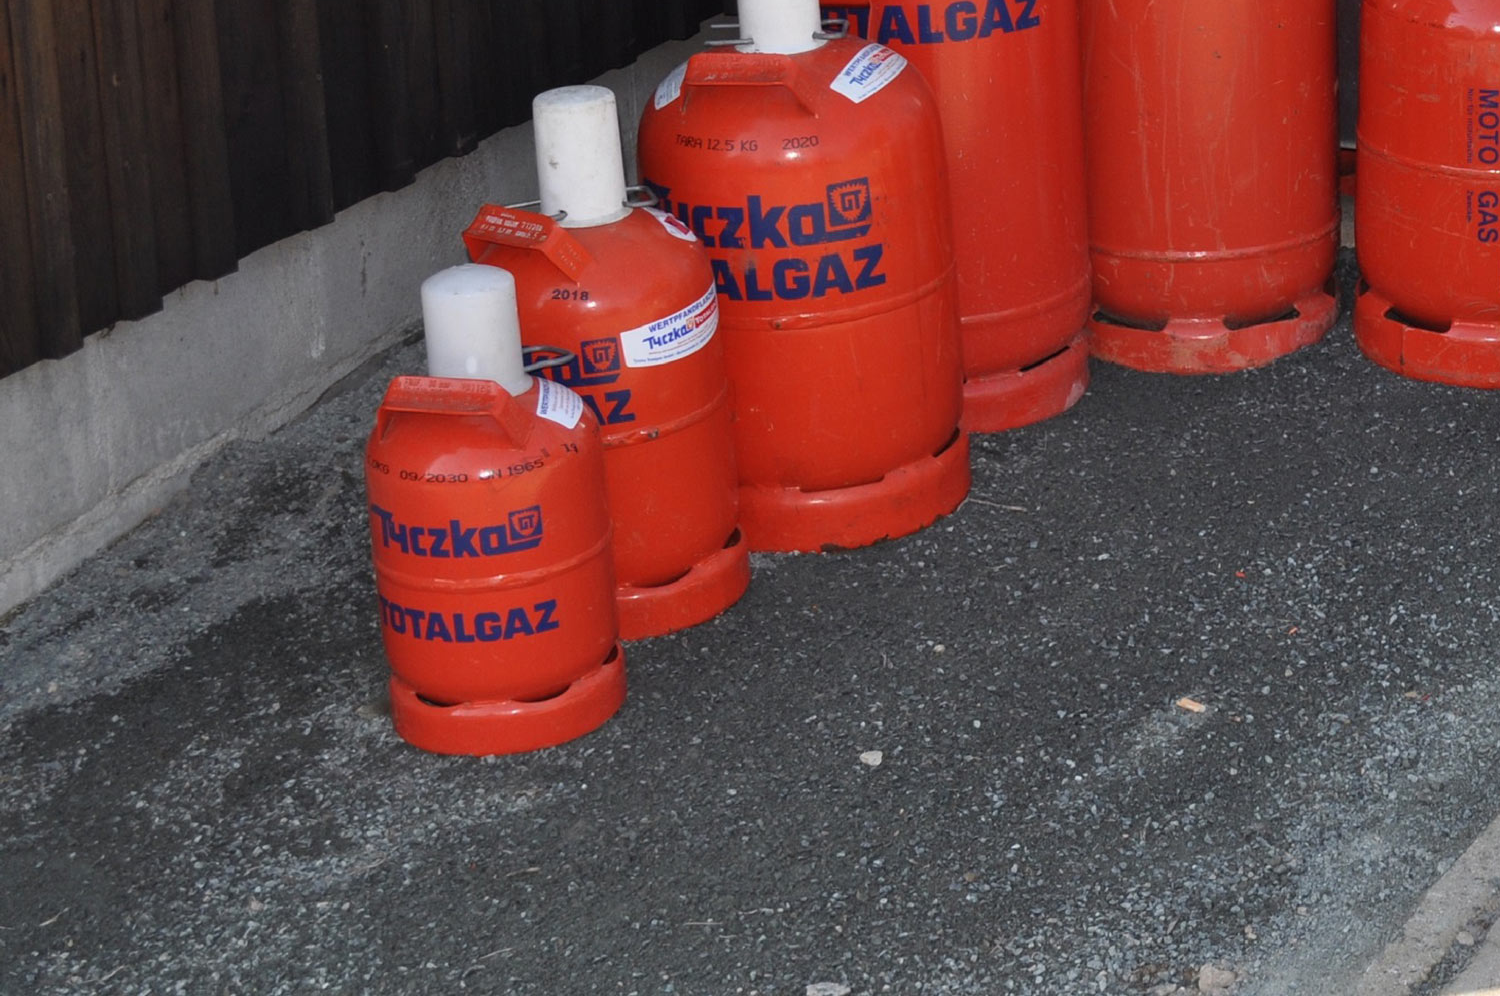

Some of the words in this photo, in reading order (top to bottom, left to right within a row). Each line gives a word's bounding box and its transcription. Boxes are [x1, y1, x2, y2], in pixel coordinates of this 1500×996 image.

[674, 133, 703, 149] TARA
[706, 137, 735, 152] 12.5
[740, 139, 758, 152] KG
[782, 135, 819, 151] 2020
[1477, 88, 1500, 165] MOTO
[1477, 190, 1499, 244] GAS
[552, 288, 589, 301] 2018
[710, 243, 887, 301] ALGAZ
[642, 322, 691, 350] Tyczka
[399, 469, 469, 484] 09/2030
[506, 457, 545, 476] 1965
[371, 502, 512, 558] Tyczka
[379, 593, 560, 643] TOTALGAZ
